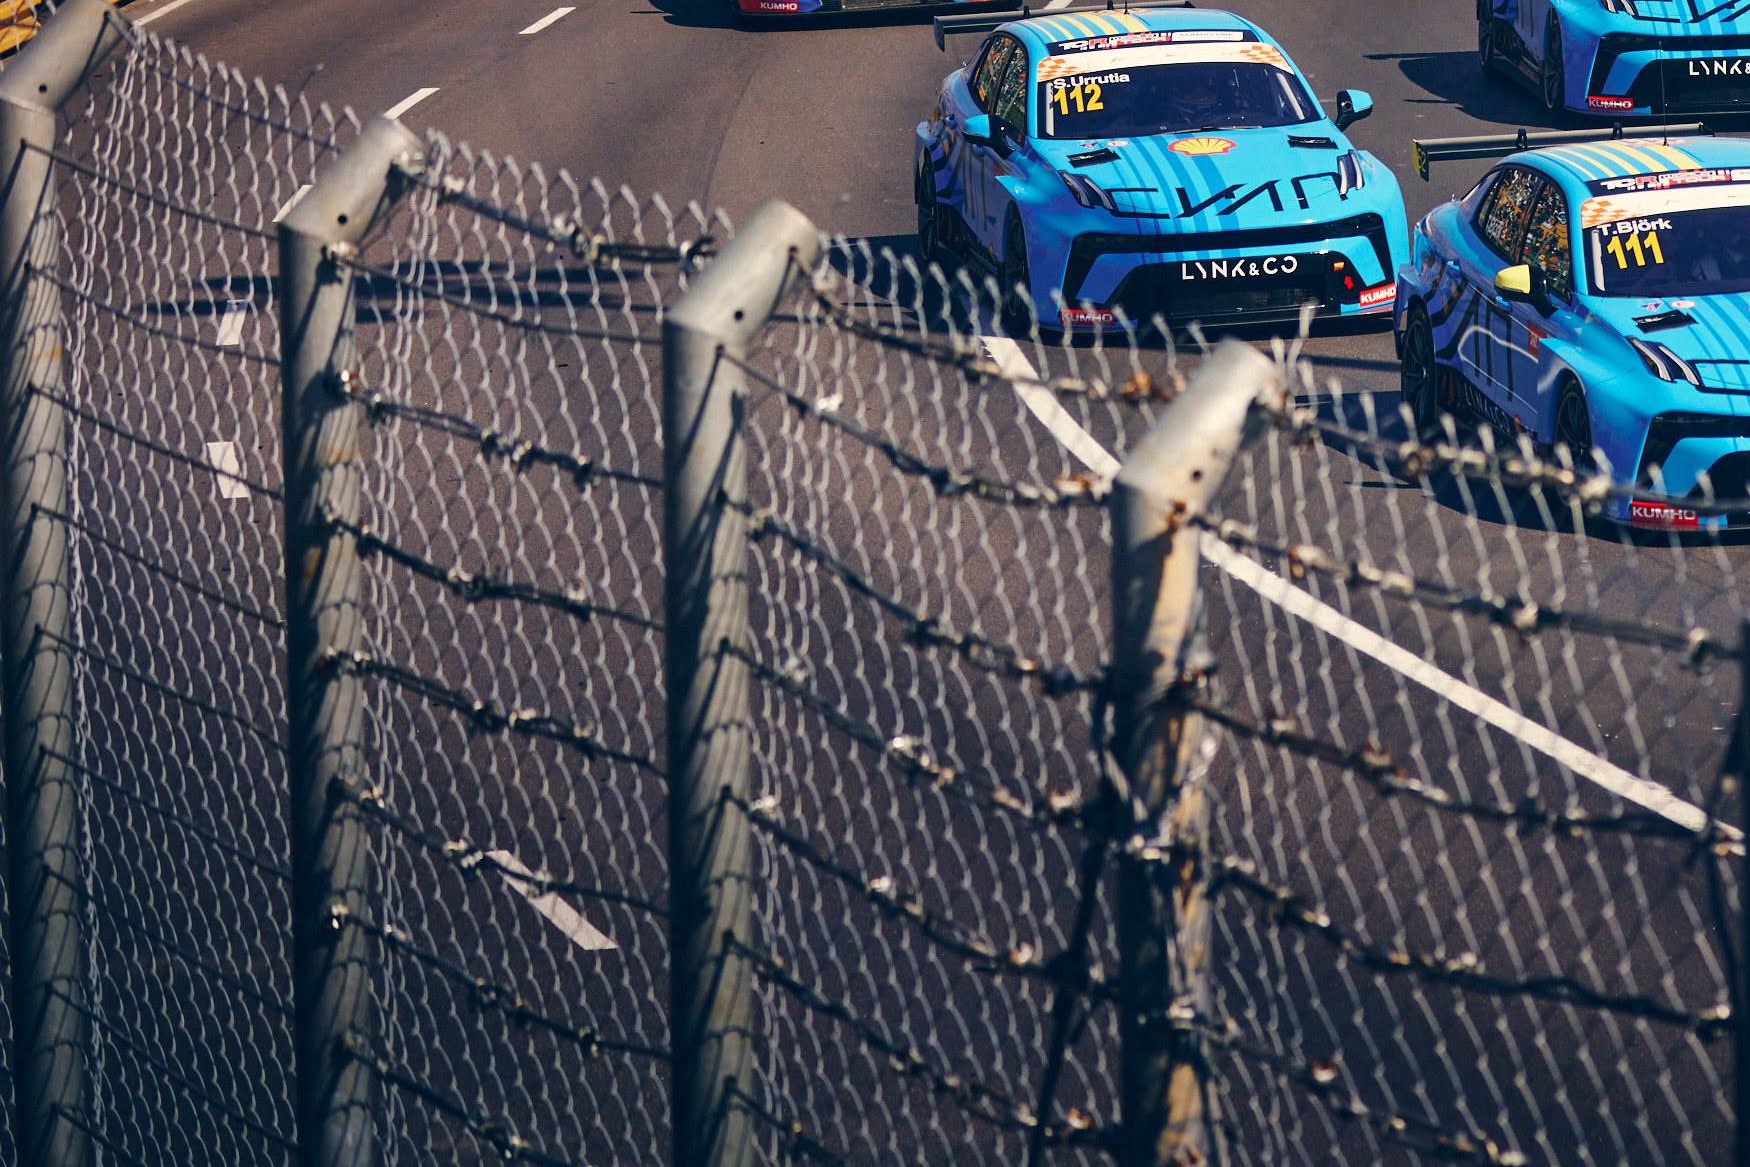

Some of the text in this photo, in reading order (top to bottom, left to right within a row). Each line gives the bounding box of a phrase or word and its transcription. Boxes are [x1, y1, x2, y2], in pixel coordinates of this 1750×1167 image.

[760, 1, 798, 11] KUMHO
[1053, 72, 1130, 89] S.Urrutia
[1053, 83, 1104, 116] 112
[1588, 98, 1633, 112] KUMHO
[1597, 218, 1673, 236] T.Björk
[1606, 231, 1665, 270] 111
[1361, 286, 1397, 305] KUMHO
[1061, 309, 1114, 324] KUMHO
[1631, 504, 1698, 523] KUMHO
